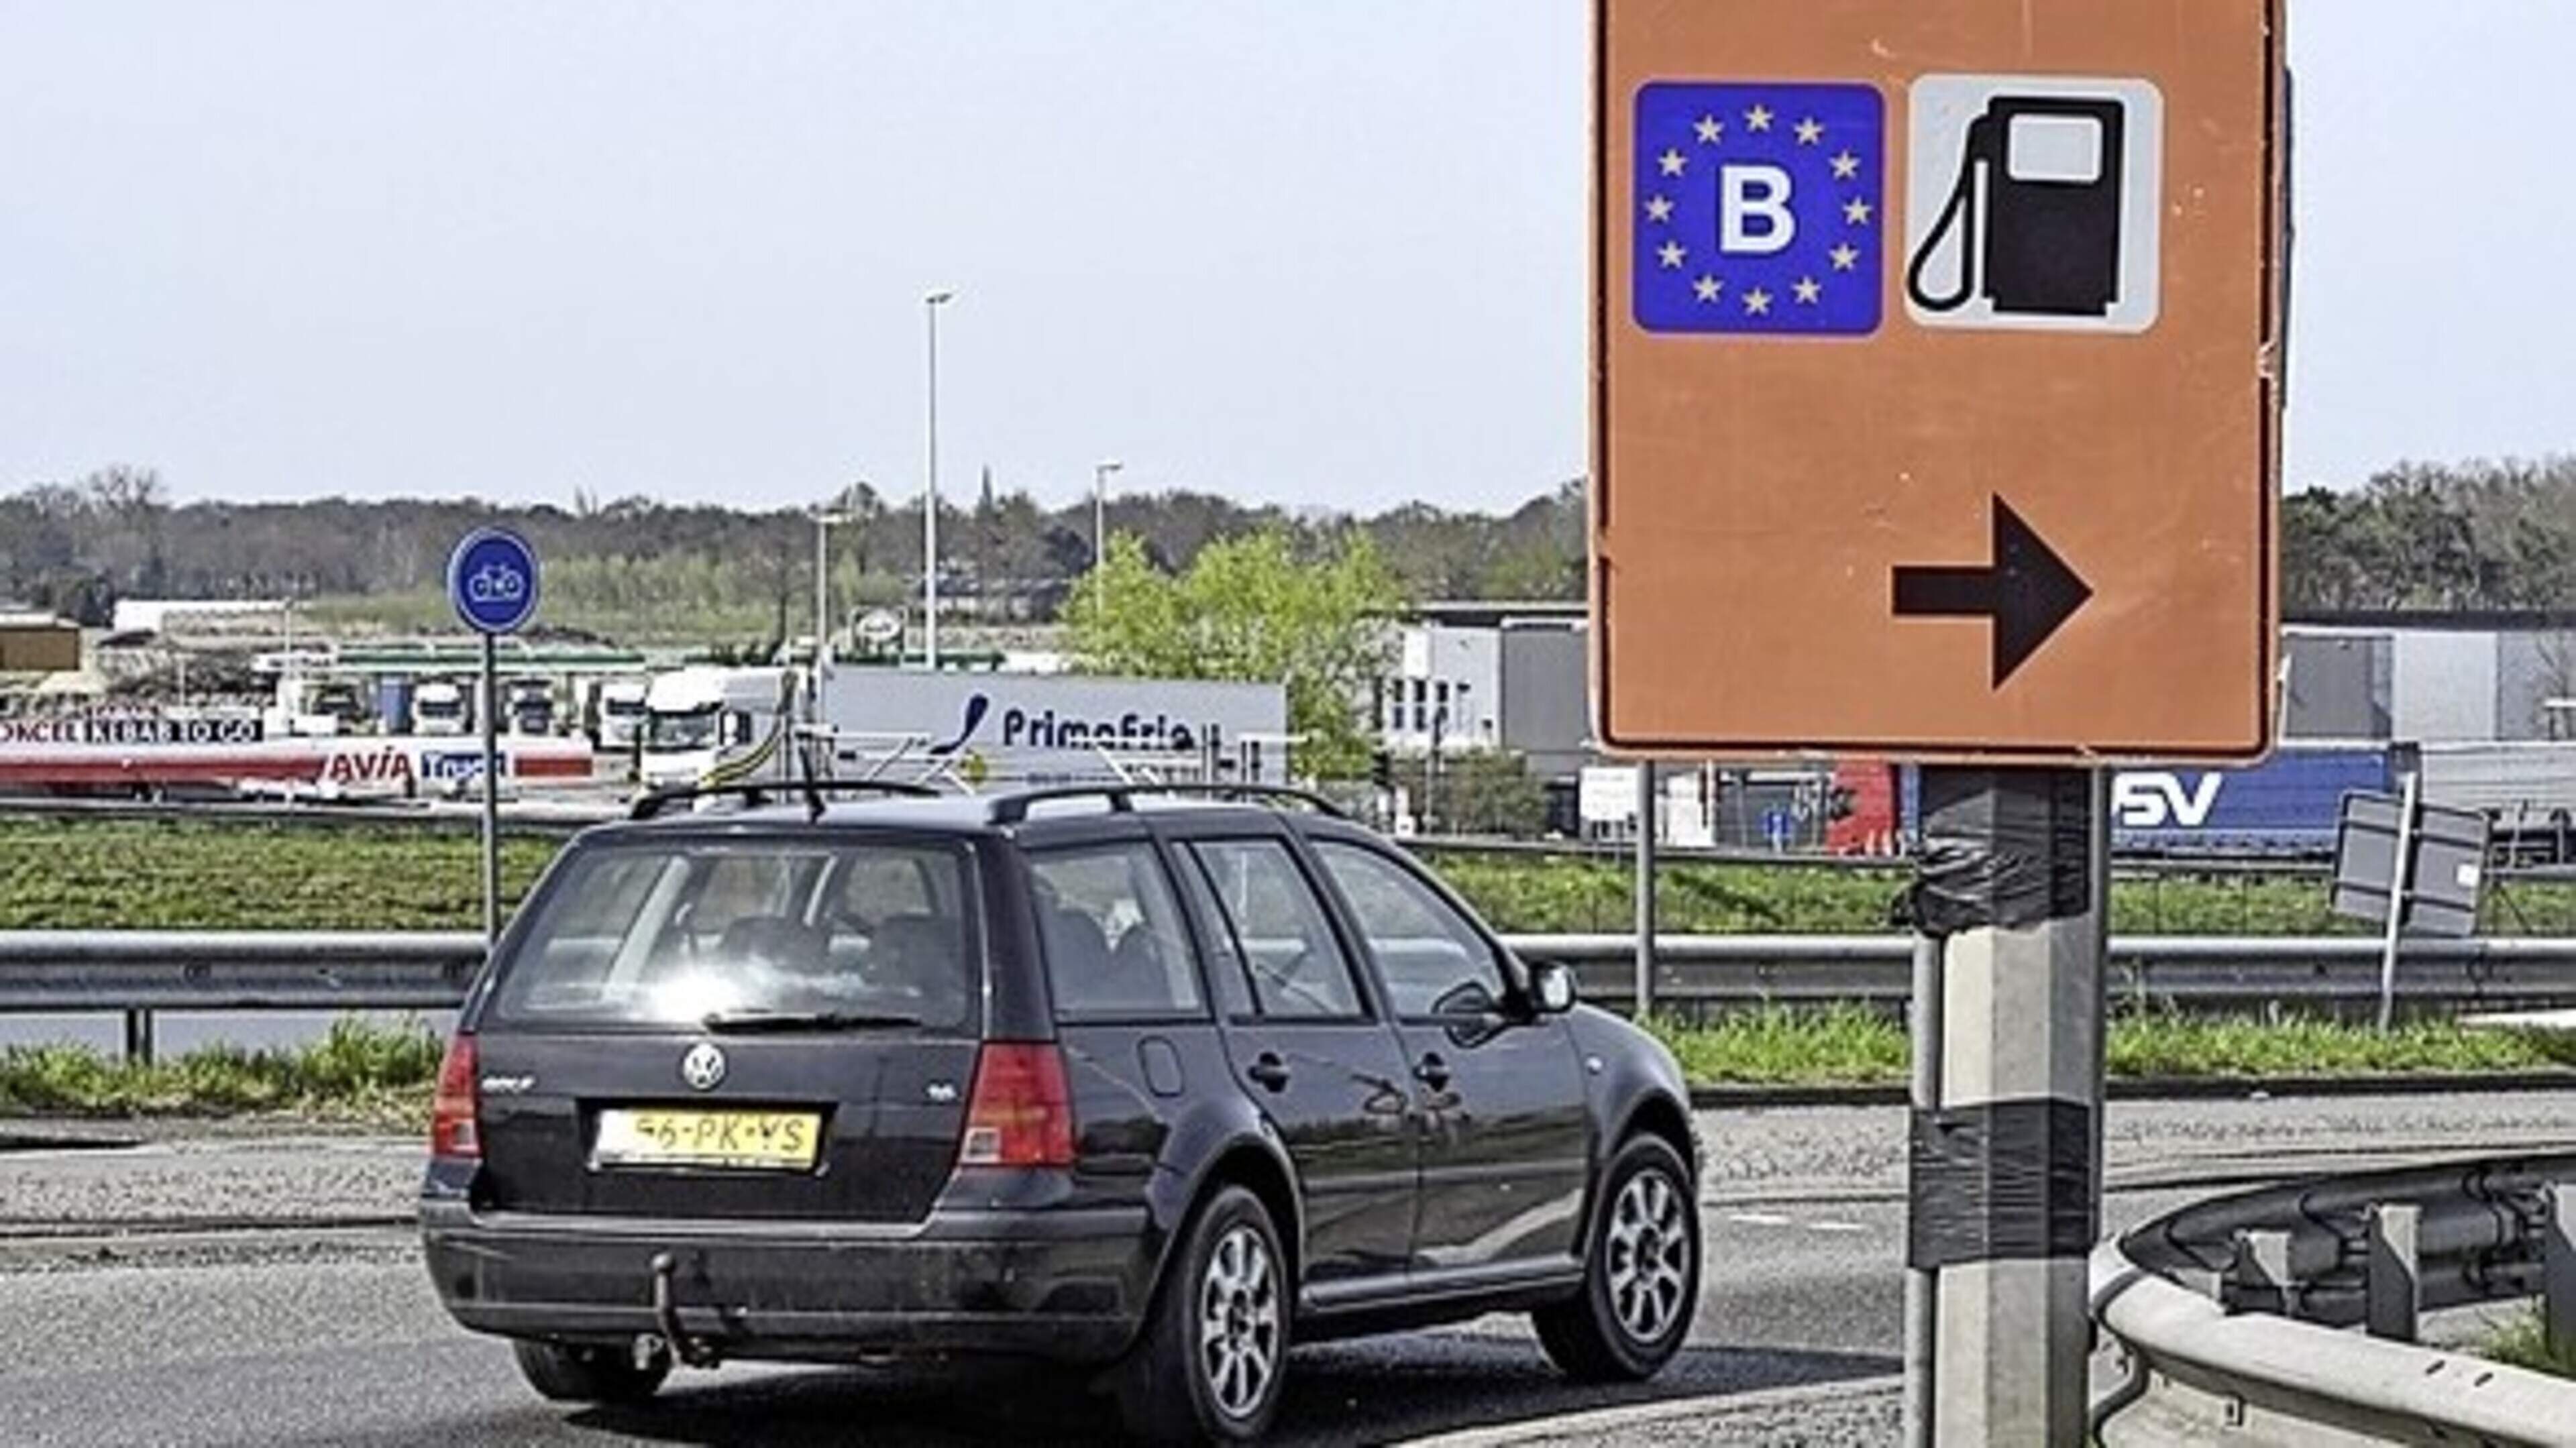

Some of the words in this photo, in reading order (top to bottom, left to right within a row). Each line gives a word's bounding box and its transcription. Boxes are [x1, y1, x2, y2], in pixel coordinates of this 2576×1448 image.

[1720, 165, 1796, 253] B
[217, 720, 258, 742] GO
[2111, 772, 2222, 826] SV
